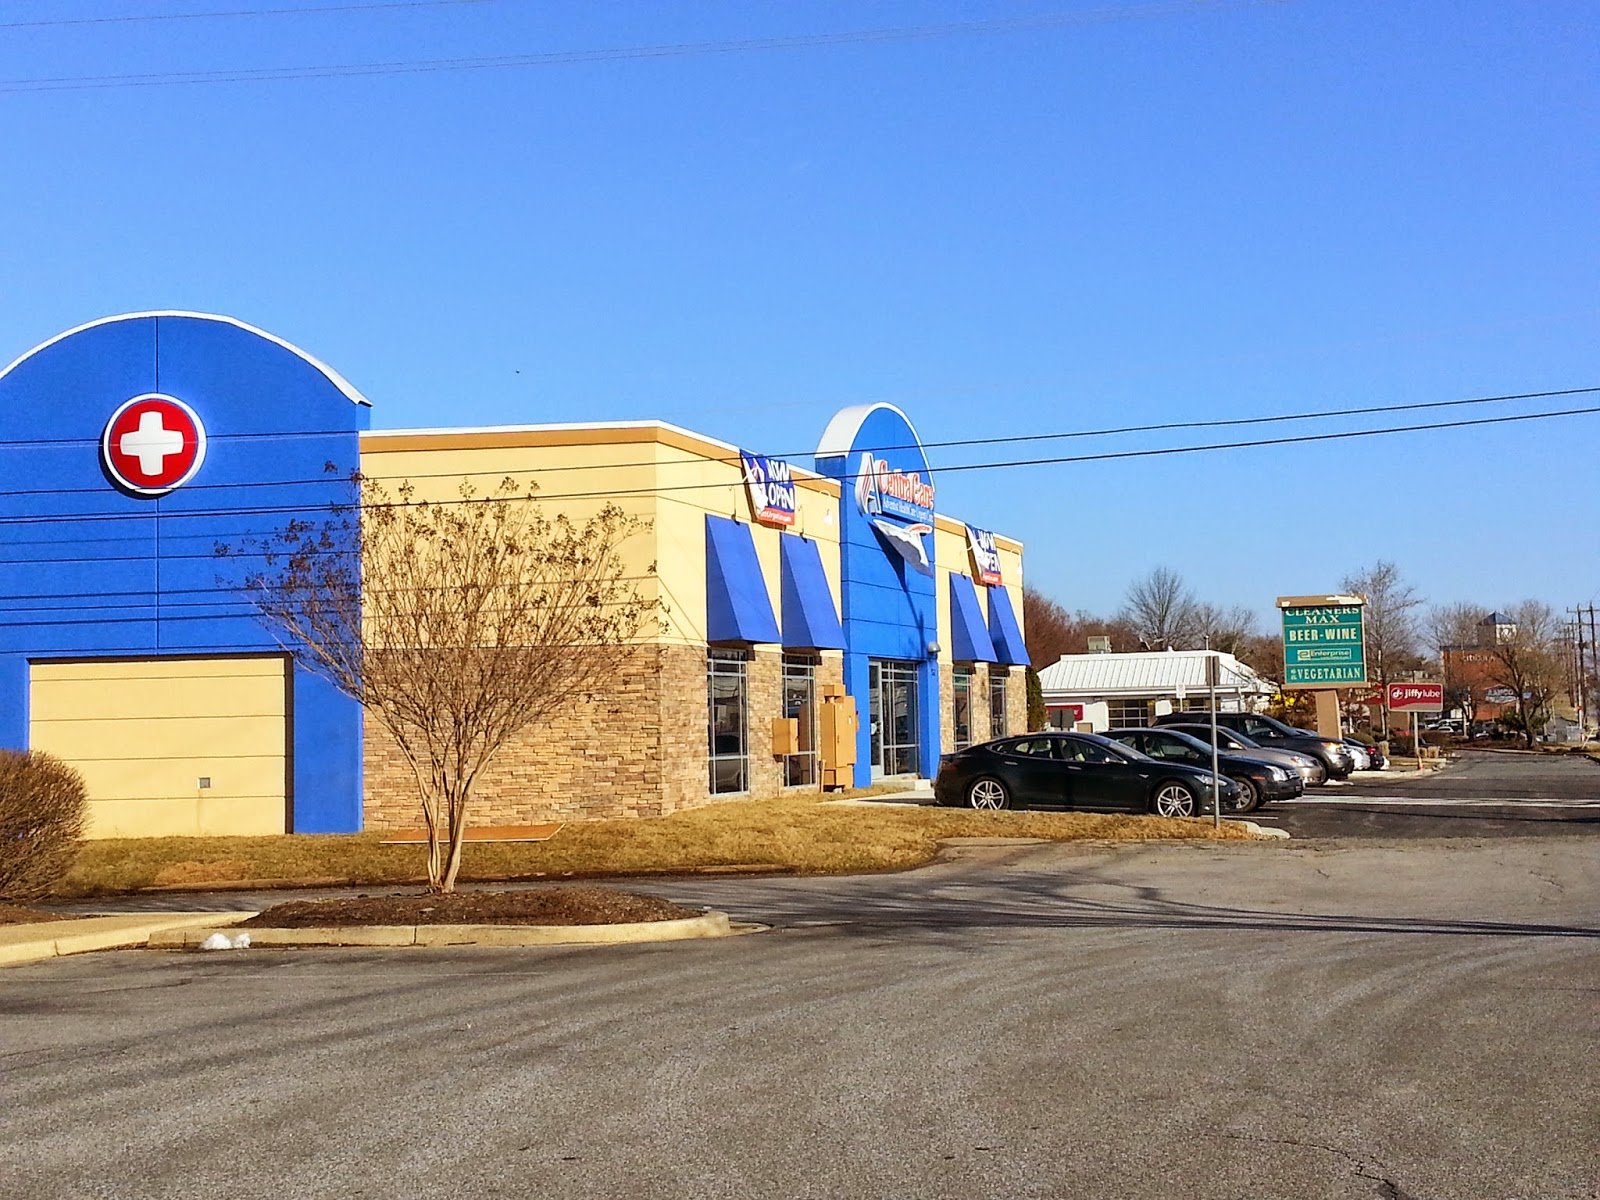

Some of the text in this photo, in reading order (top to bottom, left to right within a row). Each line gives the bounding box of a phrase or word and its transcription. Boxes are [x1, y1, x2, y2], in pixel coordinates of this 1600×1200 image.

[768, 482, 794, 510] OPEN
[1285, 607, 1359, 616] CLEANERS
[1305, 615, 1340, 625] MAX
[1289, 628, 1357, 641] BEER-WINE
[1310, 650, 1350, 658] Enterprise
[1297, 667, 1360, 680] VEGETARIAN
